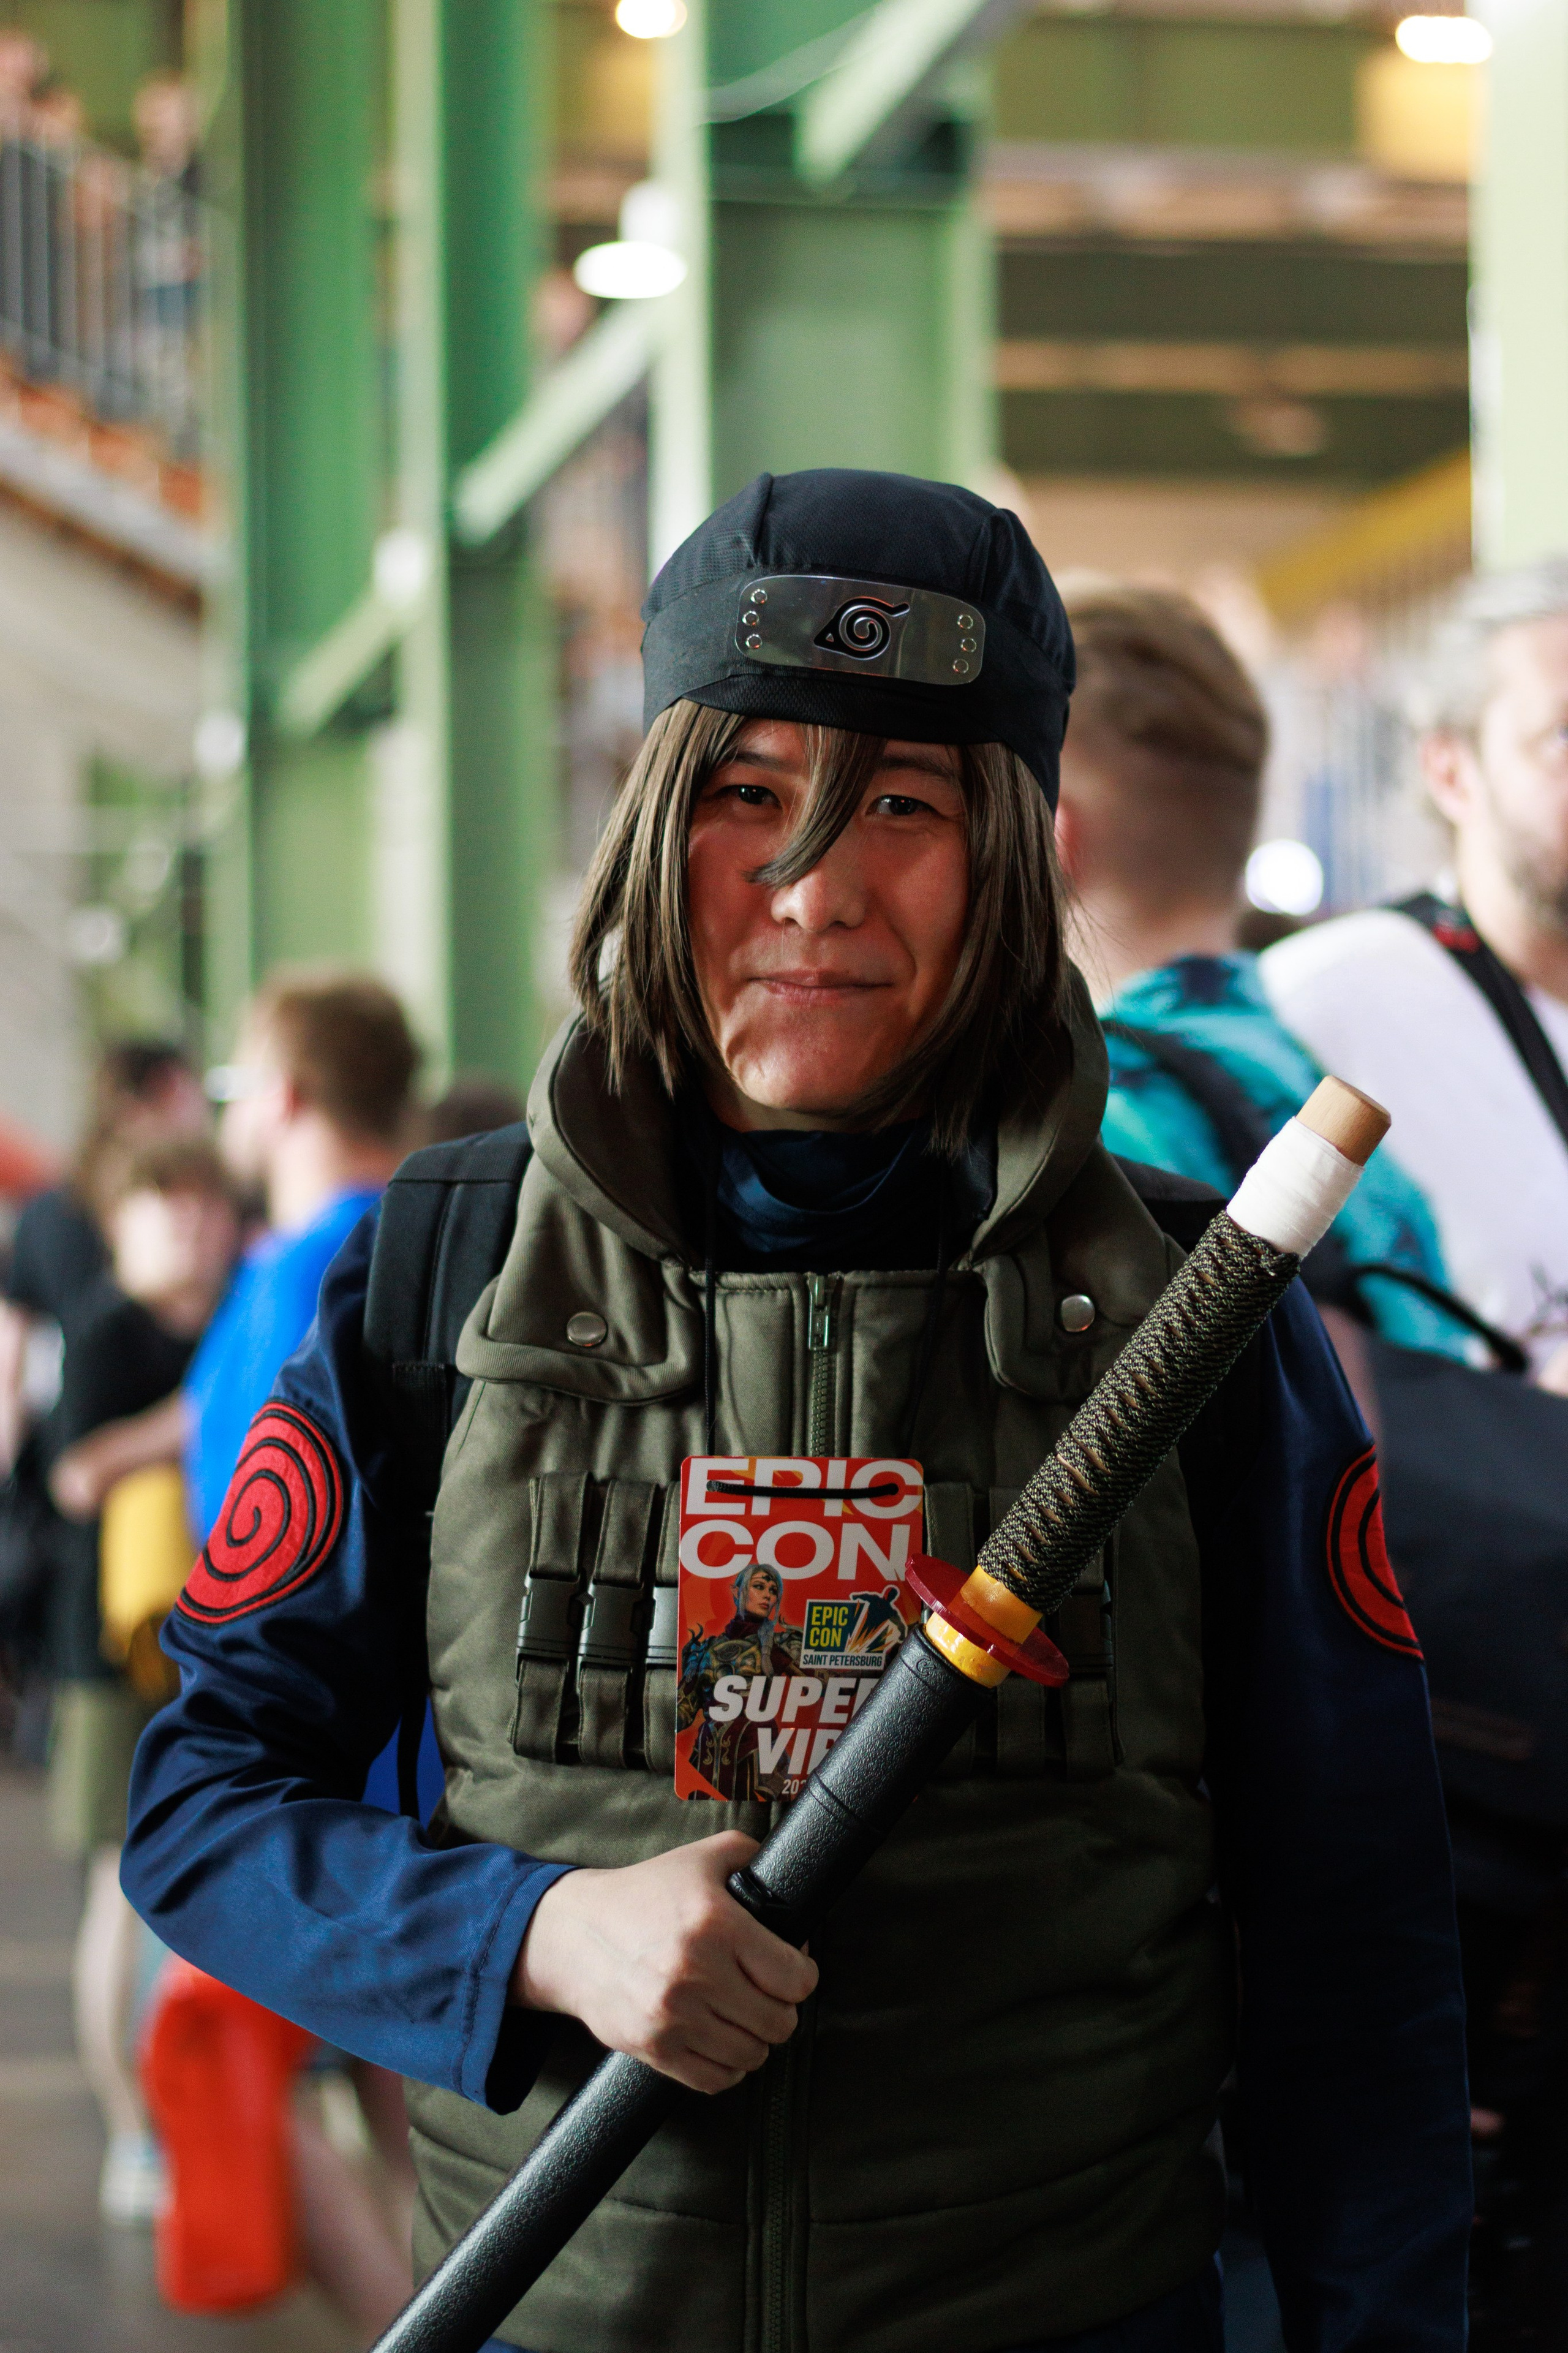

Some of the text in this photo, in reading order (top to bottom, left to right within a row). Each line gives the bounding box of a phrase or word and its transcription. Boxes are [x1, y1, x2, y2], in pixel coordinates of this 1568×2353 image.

[685, 1457, 923, 1519] EPIC
[679, 1519, 911, 1581] CON
[811, 1606, 849, 1626] EPIC
[809, 1627, 842, 1647] CON
[802, 1654, 883, 1667] SAINT PETERSBURG
